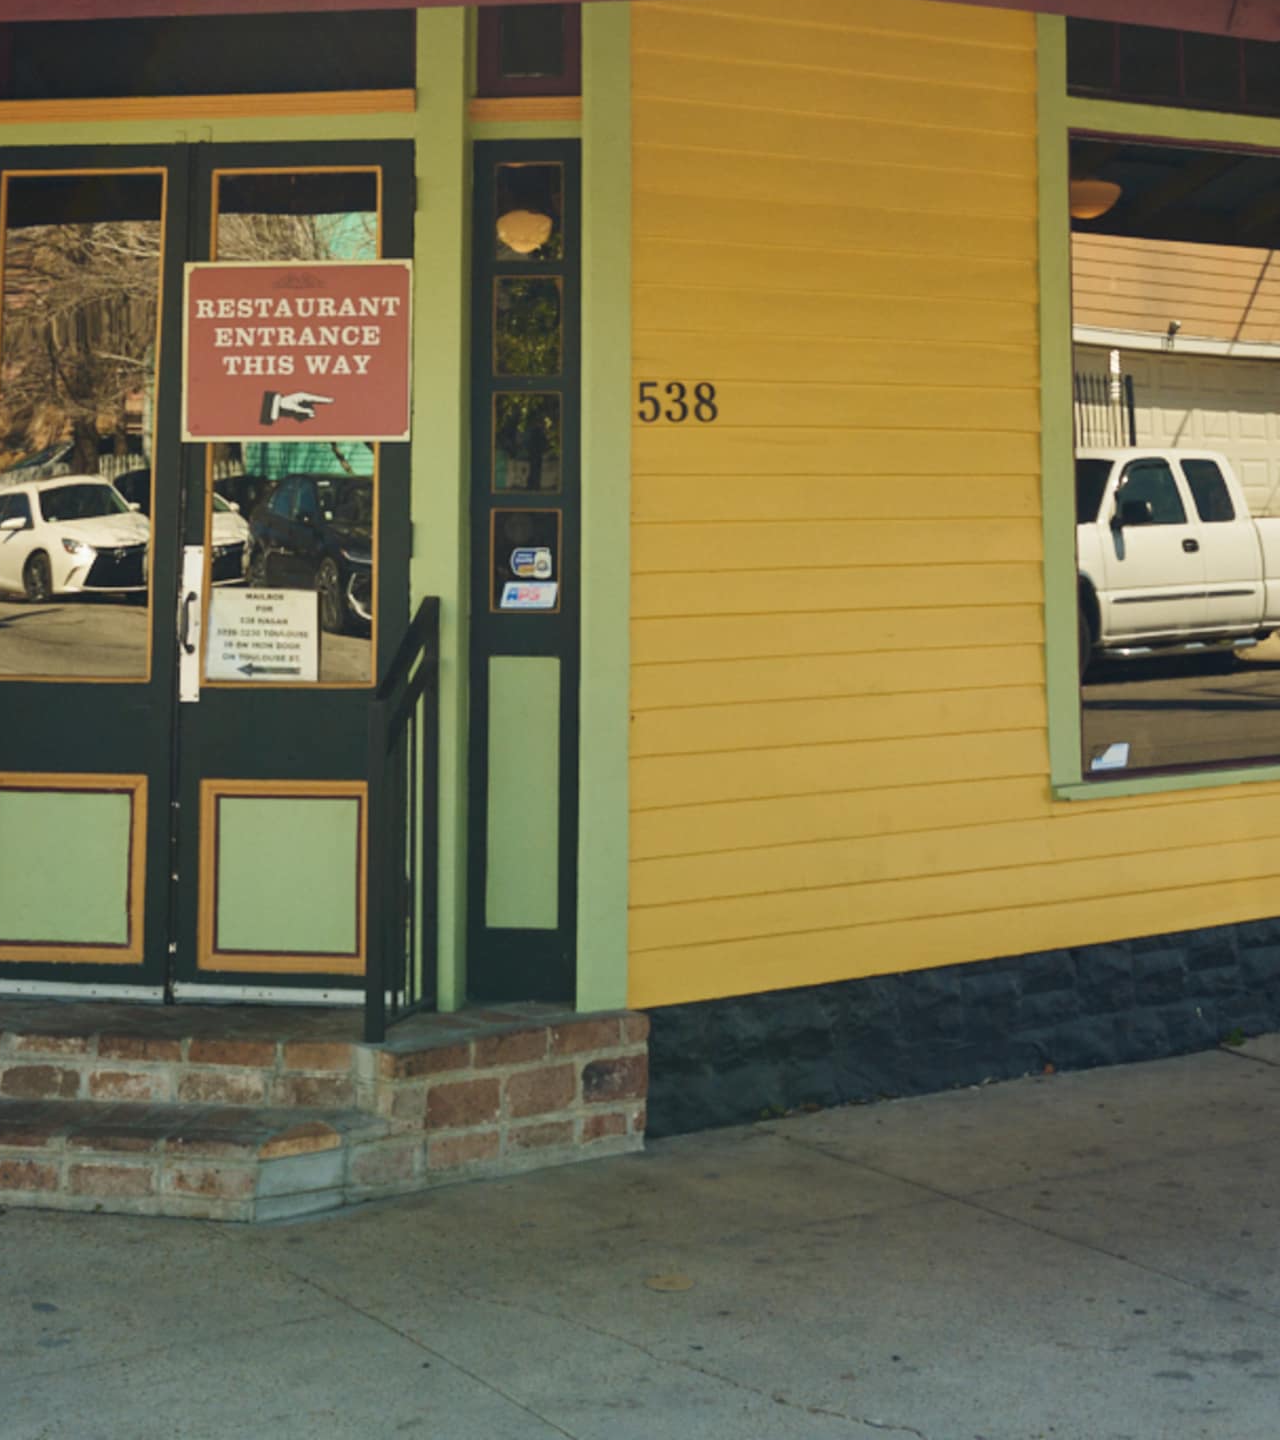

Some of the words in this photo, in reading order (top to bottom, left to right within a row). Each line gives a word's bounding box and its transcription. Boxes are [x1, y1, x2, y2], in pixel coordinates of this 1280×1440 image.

[195, 297, 401, 319] RESTAURANT
[214, 326, 381, 347] ENTRANCE
[223, 355, 295, 376] THIS
[304, 354, 372, 375] WAY
[638, 381, 718, 423] 538
